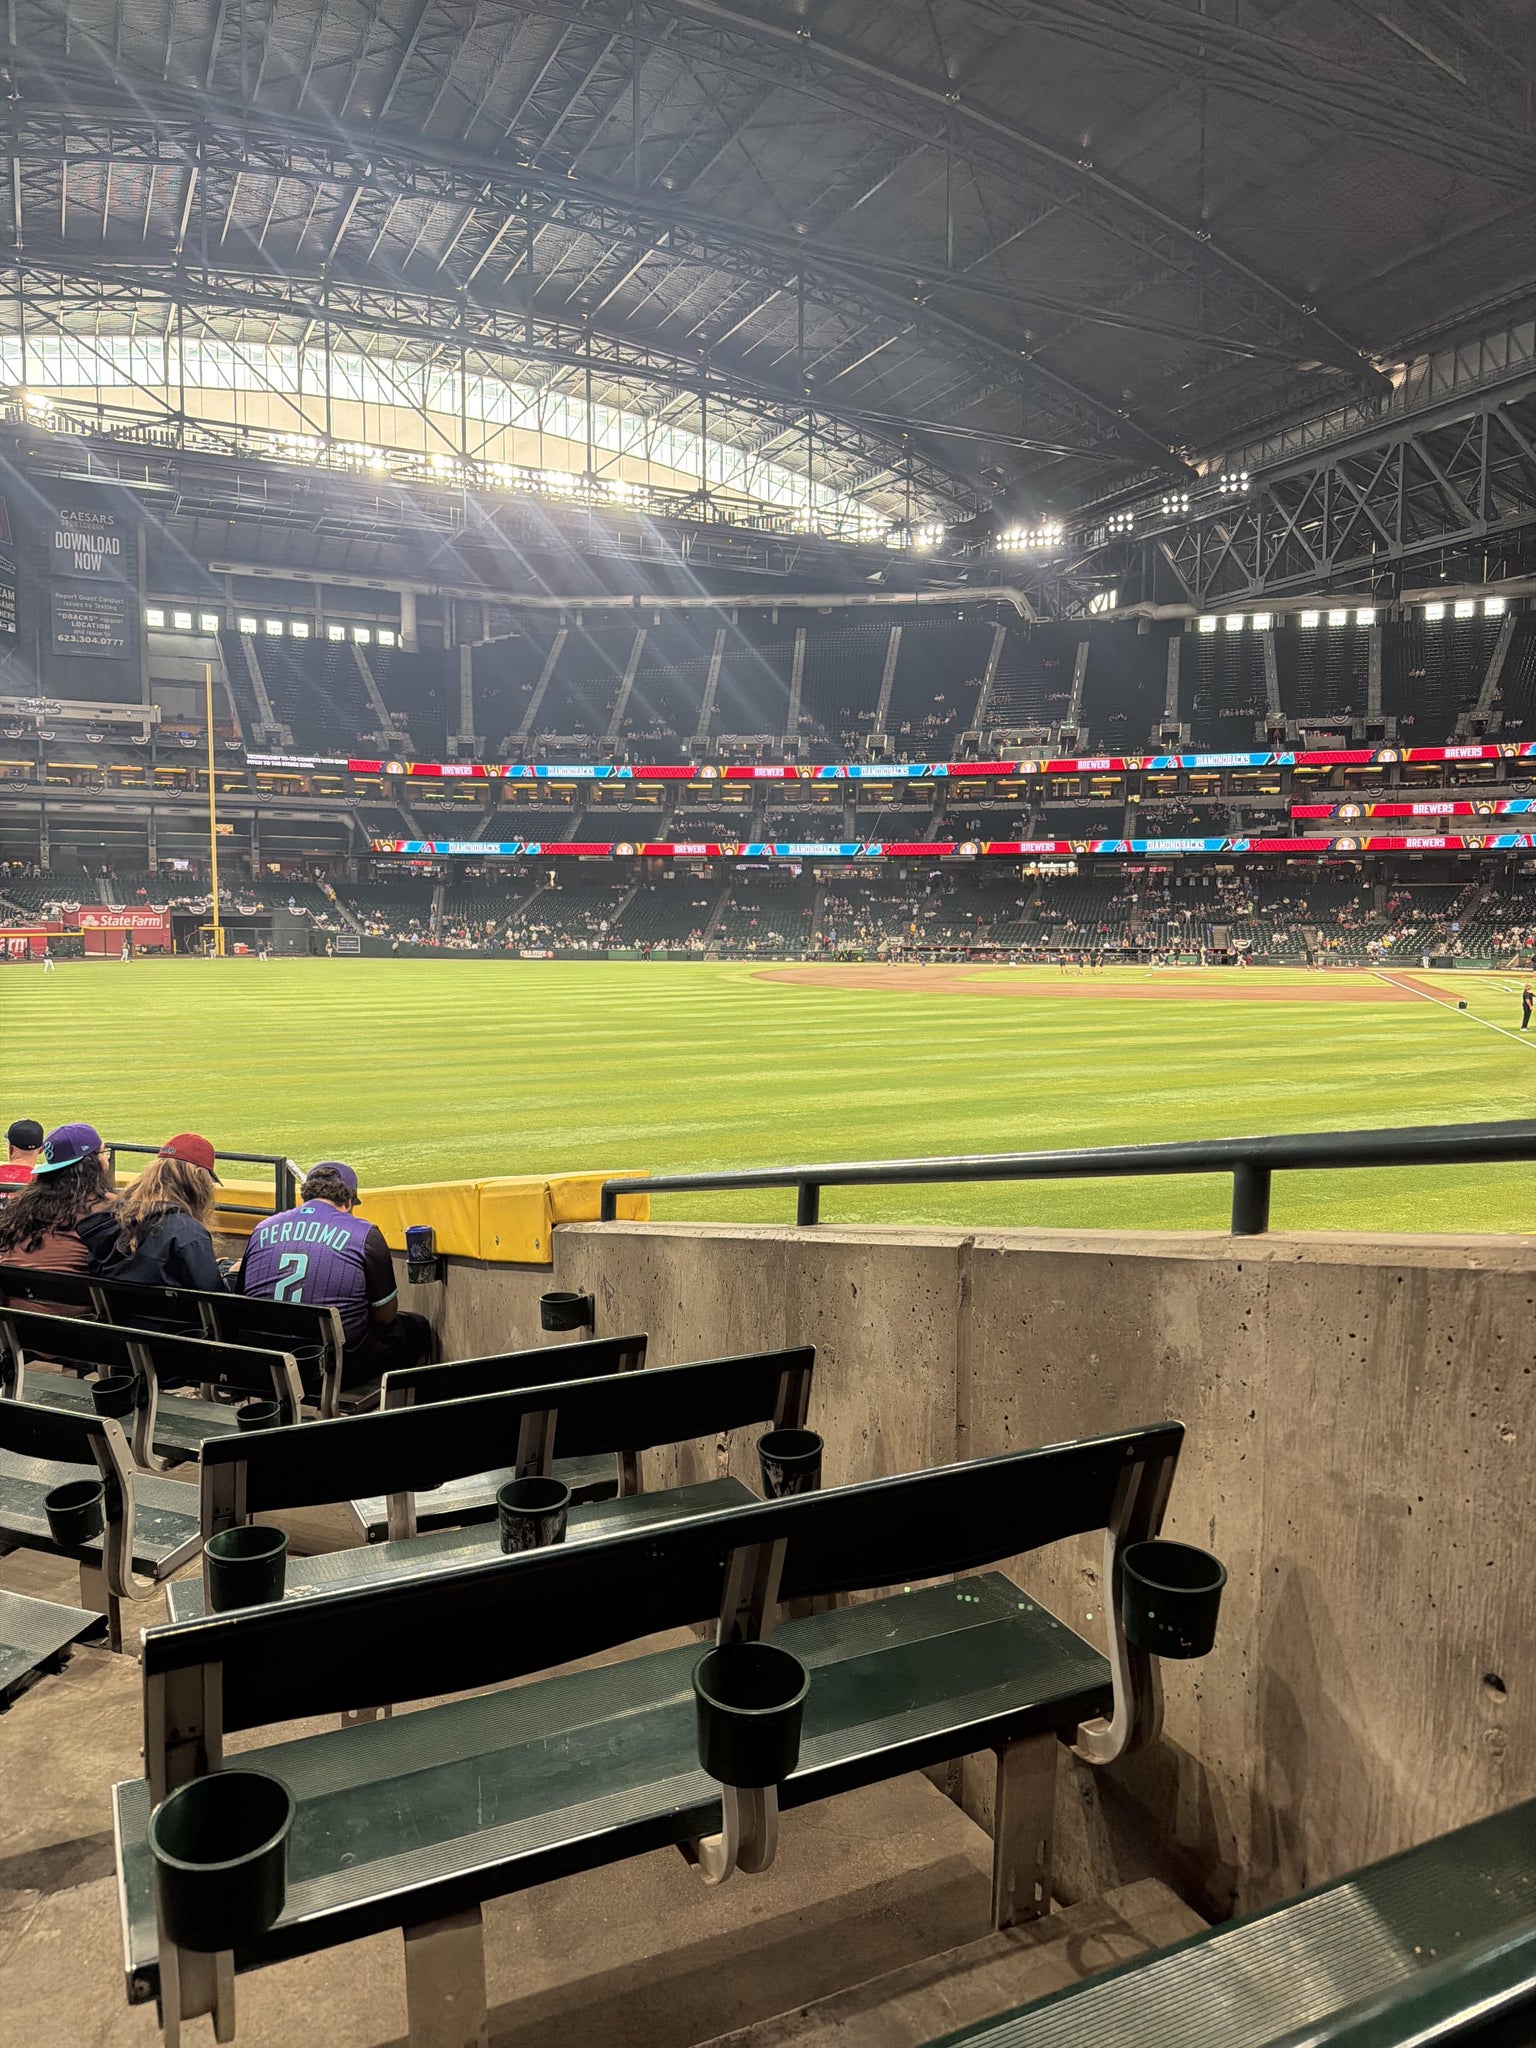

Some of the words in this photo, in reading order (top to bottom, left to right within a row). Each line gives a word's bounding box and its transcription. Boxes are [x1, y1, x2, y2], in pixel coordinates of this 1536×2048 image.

[60, 510, 114, 525] CAESARS
[55, 531, 120, 555] DOWNLOAD
[74, 551, 102, 571] NOW
[55, 592, 77, 601] Report
[72, 621, 110, 630] LOCATION
[57, 634, 124, 646] 623.304.0777
[1445, 747, 1482, 758] BREWERS
[1078, 760, 1110, 770] BREWERS
[1196, 756, 1250, 766] DIAMONDBACKS
[441, 766, 472, 775] BREWERS
[547, 766, 595, 776] DIAMONDBACKS
[754, 768, 784, 777] BREWERS
[861, 766, 910, 776] DIAMONDBACKS
[1413, 803, 1454, 814] BREWERS
[1147, 841, 1205, 850] DIAMONDBACKS
[1406, 837, 1445, 847] BREWERS
[449, 843, 500, 852] DIAMONDBACKS
[674, 844, 706, 853] BREWERS
[789, 844, 840, 854] DIAMONDBACKS
[1021, 843, 1055, 852] BREWERS
[260, 1221, 351, 1251] PERDOMO
[274, 1253, 308, 1304] 2
